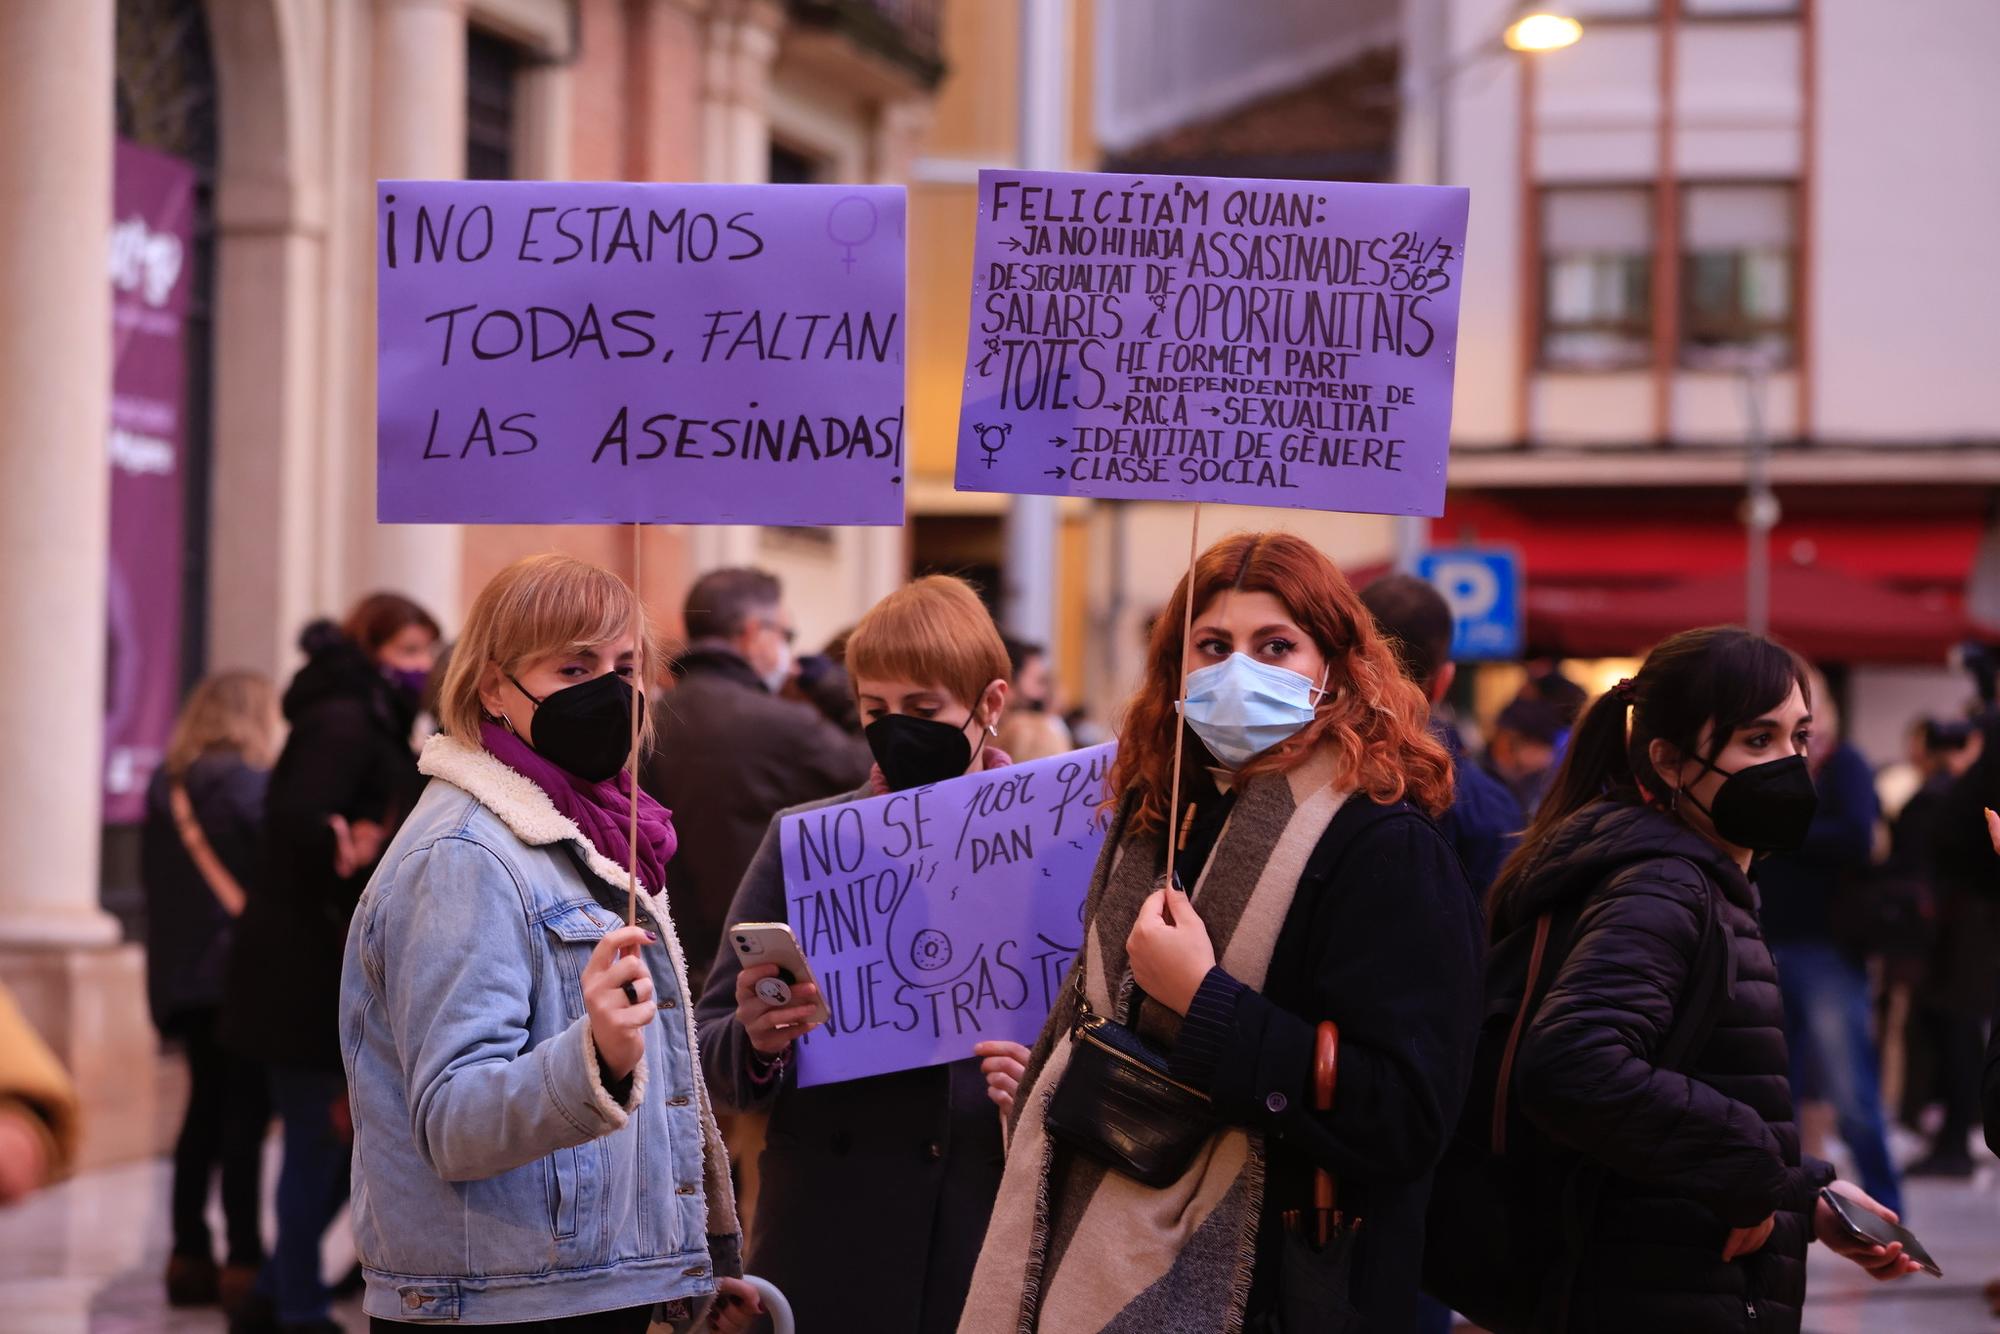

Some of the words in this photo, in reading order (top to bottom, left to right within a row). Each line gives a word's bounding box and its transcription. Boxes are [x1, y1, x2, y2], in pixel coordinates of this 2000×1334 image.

[1223, 189, 1327, 228] QUAN:
[518, 206, 764, 264] ESTAMOS
[1022, 225, 1052, 256] JA
[1058, 225, 1097, 255] NO
[1101, 227, 1126, 256] HI
[1130, 227, 1184, 260] HAJA
[1187, 231, 1390, 286] ASSASINADES
[1389, 231, 1455, 272] 24/7
[988, 262, 1137, 294] DESIGUALTAT
[1145, 263, 1177, 295] DE
[1389, 263, 1451, 295] 365
[425, 302, 674, 366] TODAS,
[702, 310, 897, 362] FALTAN
[980, 292, 1123, 340] SALARIS
[1174, 283, 1435, 358] OPORTUNITATS
[1000, 338, 1107, 411] TOTES
[1115, 341, 1153, 375] HI
[1157, 342, 1271, 377] FORMEM
[1284, 349, 1361, 380] PART
[1128, 375, 1373, 403] INDEPENDENTMENT
[1386, 385, 1416, 405] DE
[422, 407, 538, 460] LAS
[1121, 394, 1188, 428] RAÇA
[1222, 395, 1400, 434] SEXUALITAT
[1069, 455, 1171, 485] CLASSE
[1178, 457, 1300, 489] SOCIAL
[1070, 426, 1226, 460] IDENTITAT
[1234, 430, 1273, 460] DE
[1279, 428, 1407, 472] GÈNERE
[798, 808, 865, 882] NO
[882, 786, 935, 859] SÉ
[954, 772, 1036, 861] por
[970, 825, 1034, 875] DAN
[792, 868, 900, 957] TANTO
